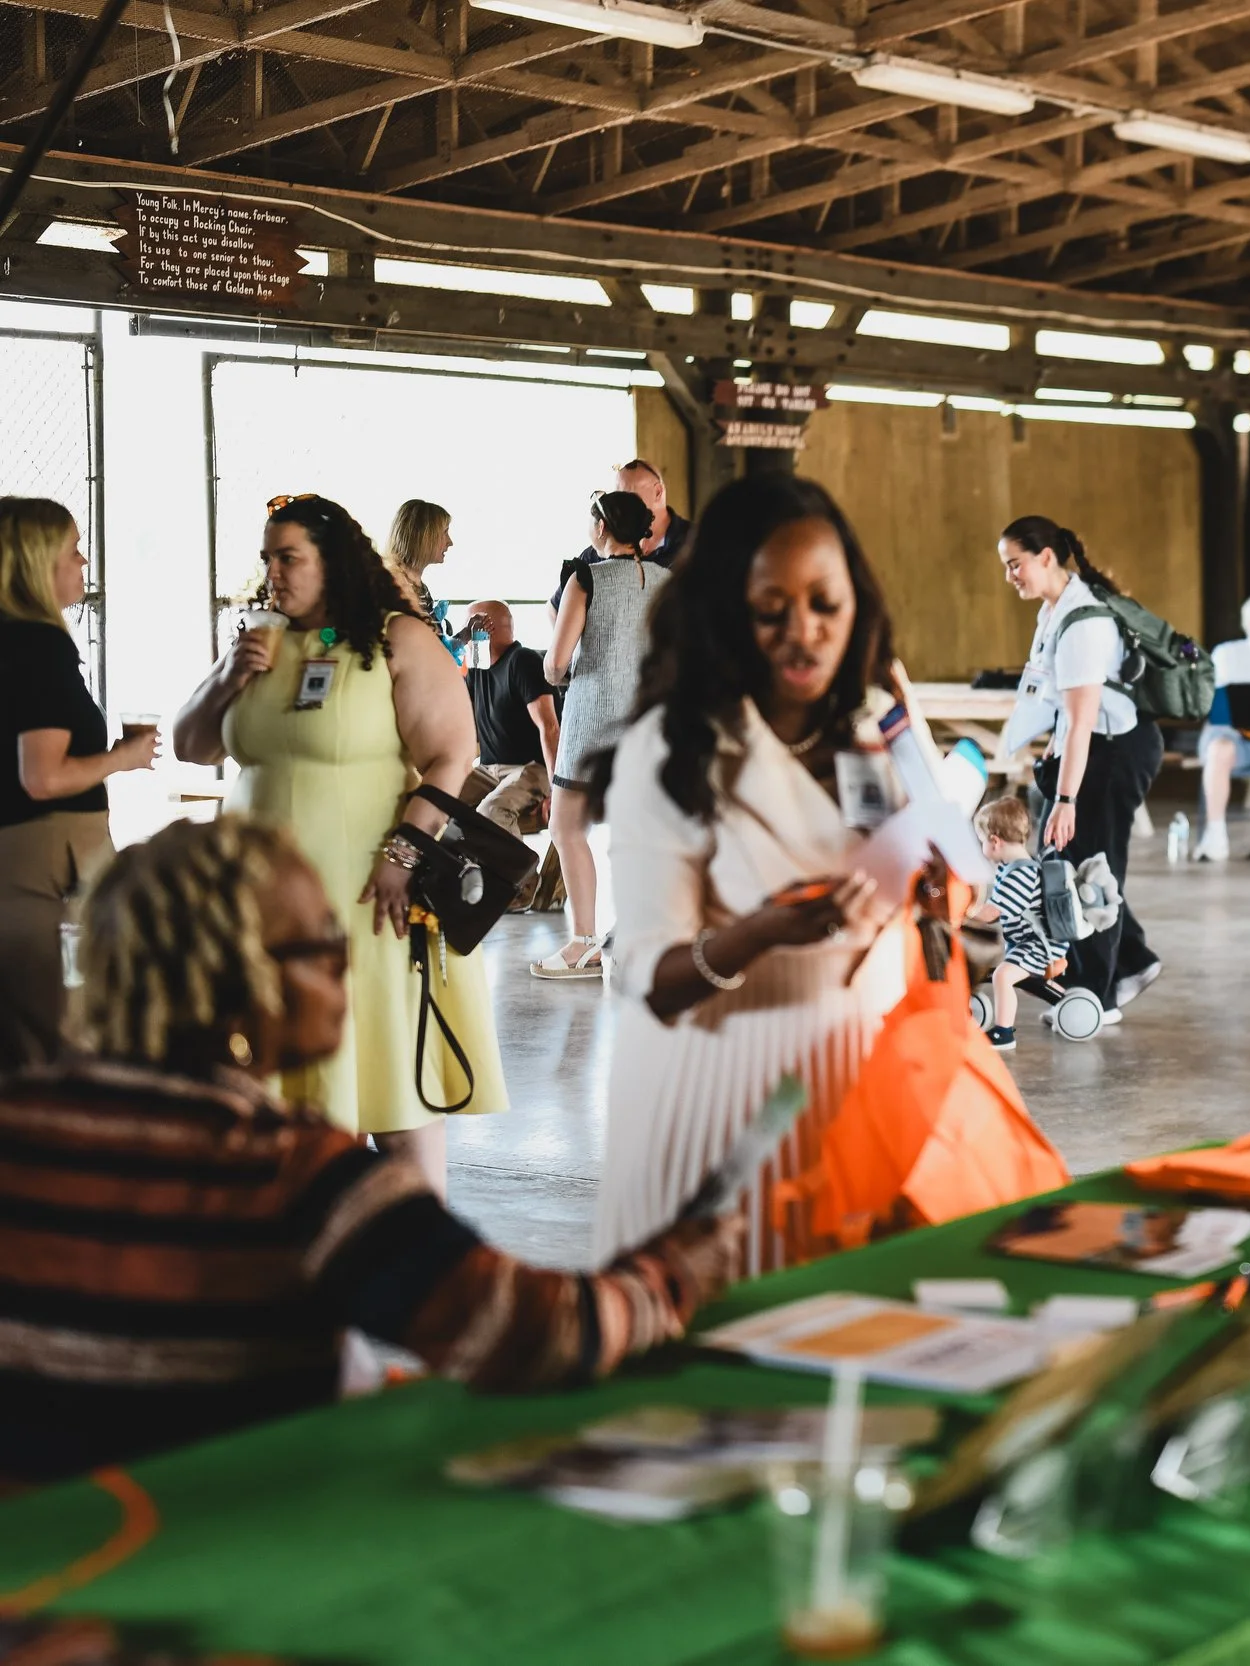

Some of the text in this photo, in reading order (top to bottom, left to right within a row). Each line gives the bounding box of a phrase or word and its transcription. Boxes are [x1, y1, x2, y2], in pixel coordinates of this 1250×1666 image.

[136, 192, 159, 212] Young
[183, 198, 191, 211] In
[193, 200, 225, 219] Mercy's
[253, 208, 288, 225] forbear,
[136, 208, 255, 236] To occupy a Rocking Chair,
[139, 224, 255, 250] If by this act you disallow
[139, 239, 152, 254] Its
[155, 247, 171, 256] use
[178, 246, 188, 258] to
[193, 251, 207, 260] one
[211, 251, 235, 263] senior
[239, 253, 248, 264] to
[138, 270, 275, 300] To comfort those of Golden Age.
[140, 256, 290, 287] For they are placed upon this stage
